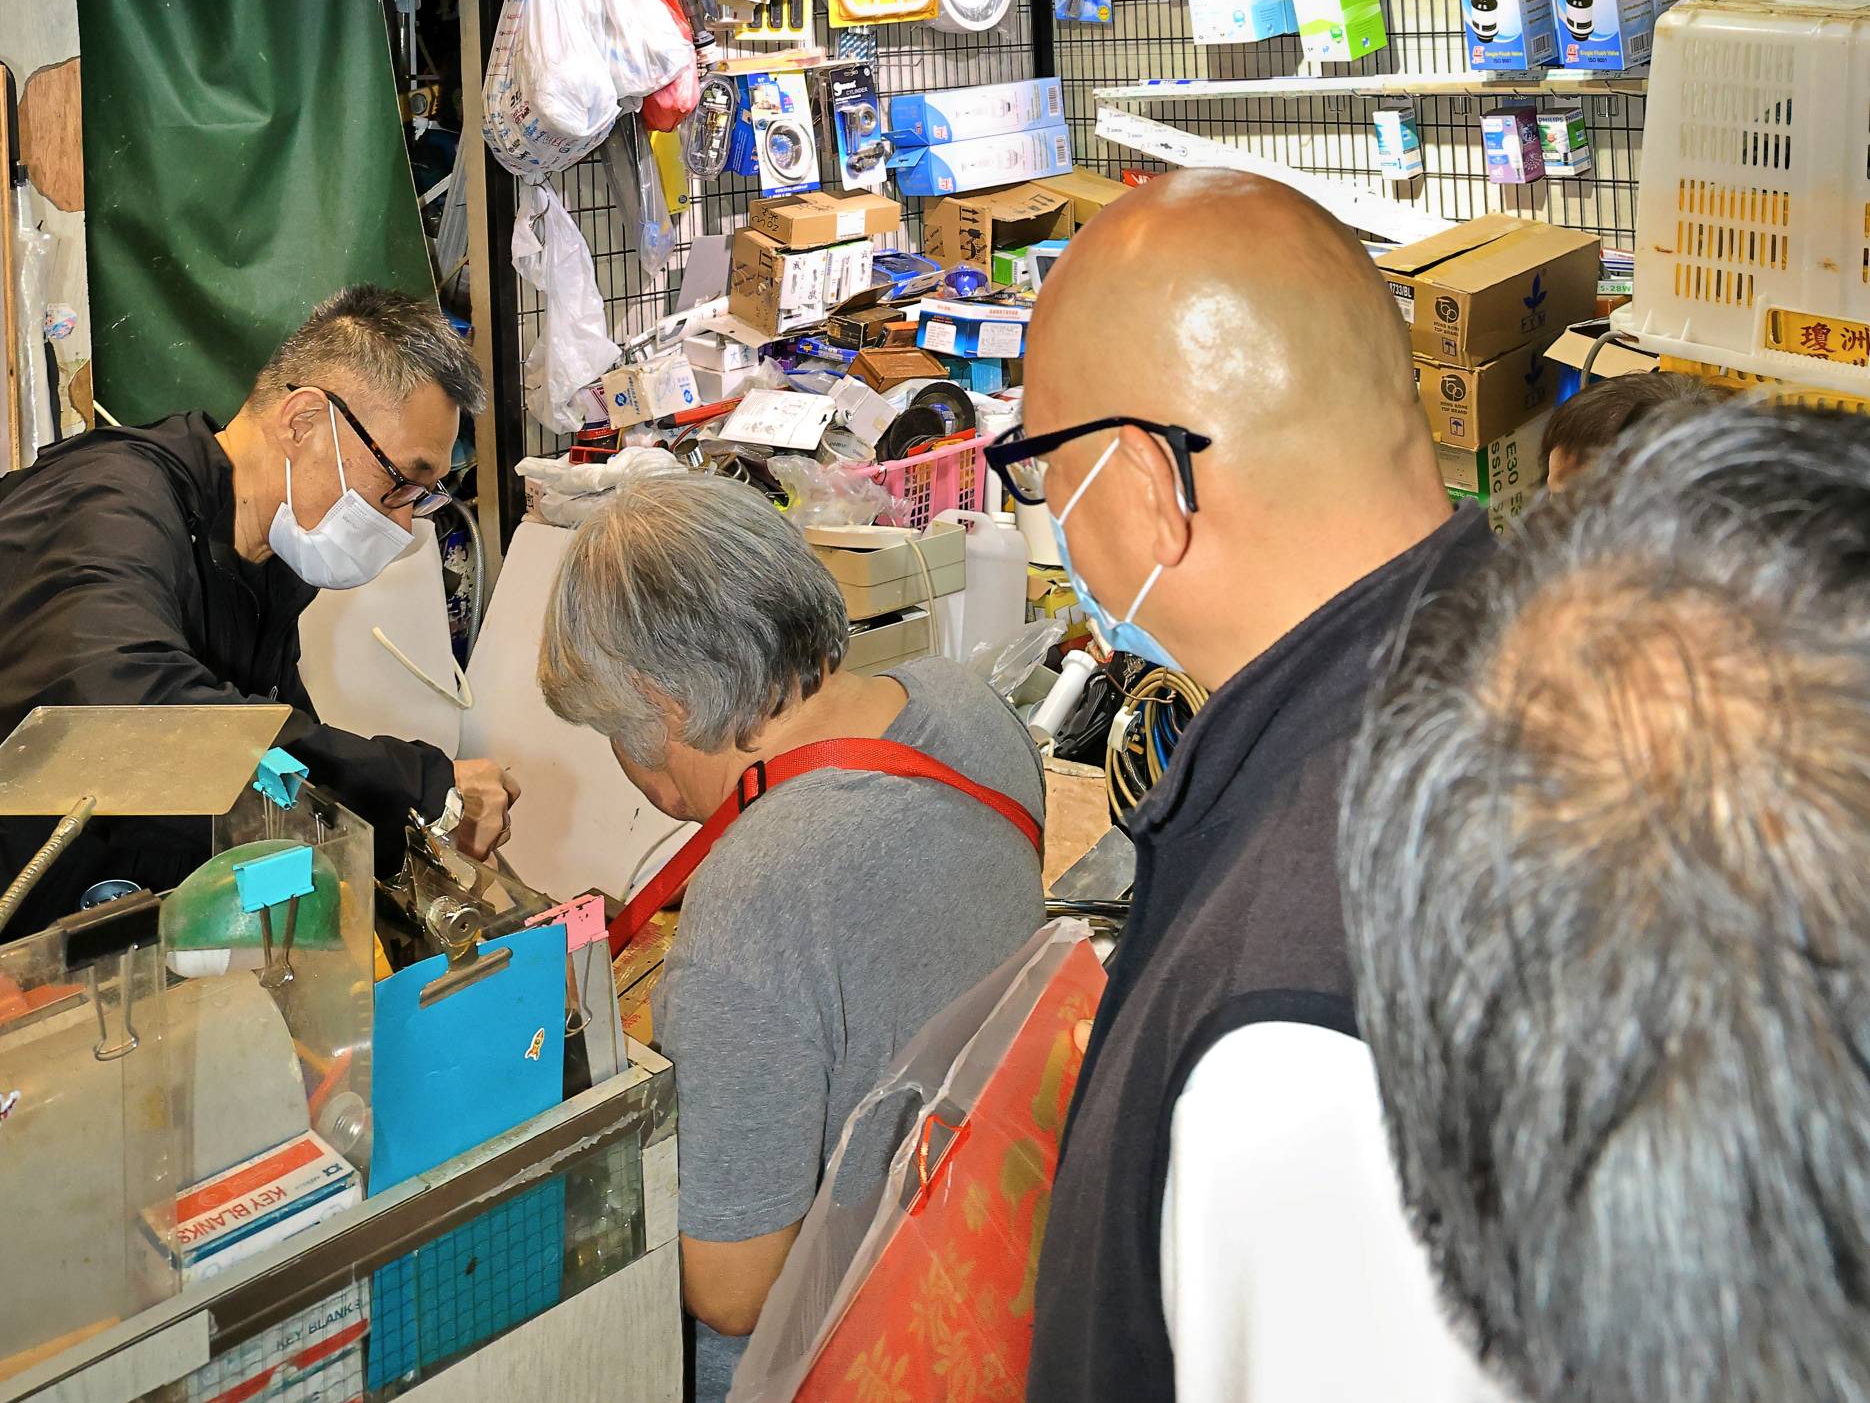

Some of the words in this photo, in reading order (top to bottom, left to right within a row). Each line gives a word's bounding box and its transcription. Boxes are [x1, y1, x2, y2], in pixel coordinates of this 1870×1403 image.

[845, 87, 868, 96] CYLINDER
[1433, 321, 1447, 329] HONG
[1800, 322, 1870, 356] 瓊洲
[1491, 441, 1502, 493] ssic
[252, 1186, 287, 1211] KEY
[177, 1203, 251, 1244] BLANKS
